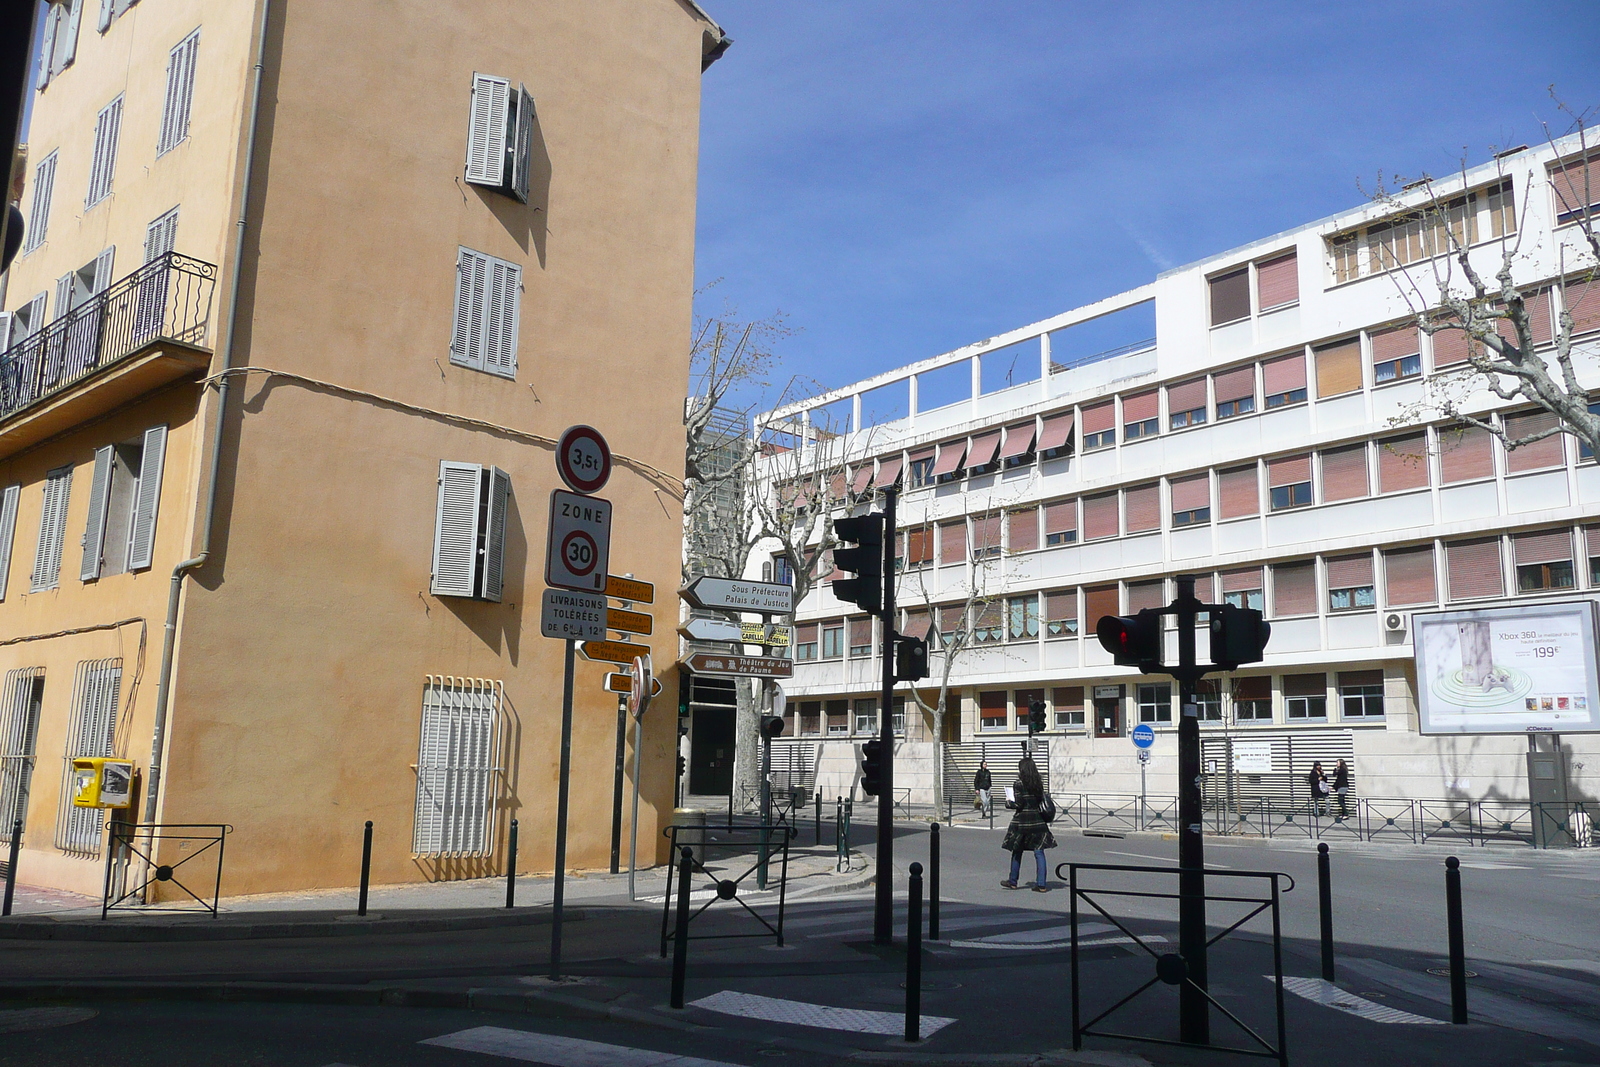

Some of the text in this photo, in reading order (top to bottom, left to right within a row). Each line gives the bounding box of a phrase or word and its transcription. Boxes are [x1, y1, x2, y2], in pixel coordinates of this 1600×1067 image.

[573, 448, 598, 471] 3,5t
[562, 503, 602, 523] ZONE
[568, 542, 591, 564] 30
[731, 584, 789, 598] Sous Préfecture
[550, 595, 603, 609] LIVRAISONS
[725, 594, 789, 608] Palais de Justice
[553, 608, 599, 622] TOLÉRÉES
[612, 612, 643, 622] Concorde
[548, 623, 557, 631] DE
[1498, 632, 1519, 640] Xbox
[1520, 631, 1536, 639] 360
[739, 658, 764, 667] Théâtre
[778, 660, 790, 668] Jeu
